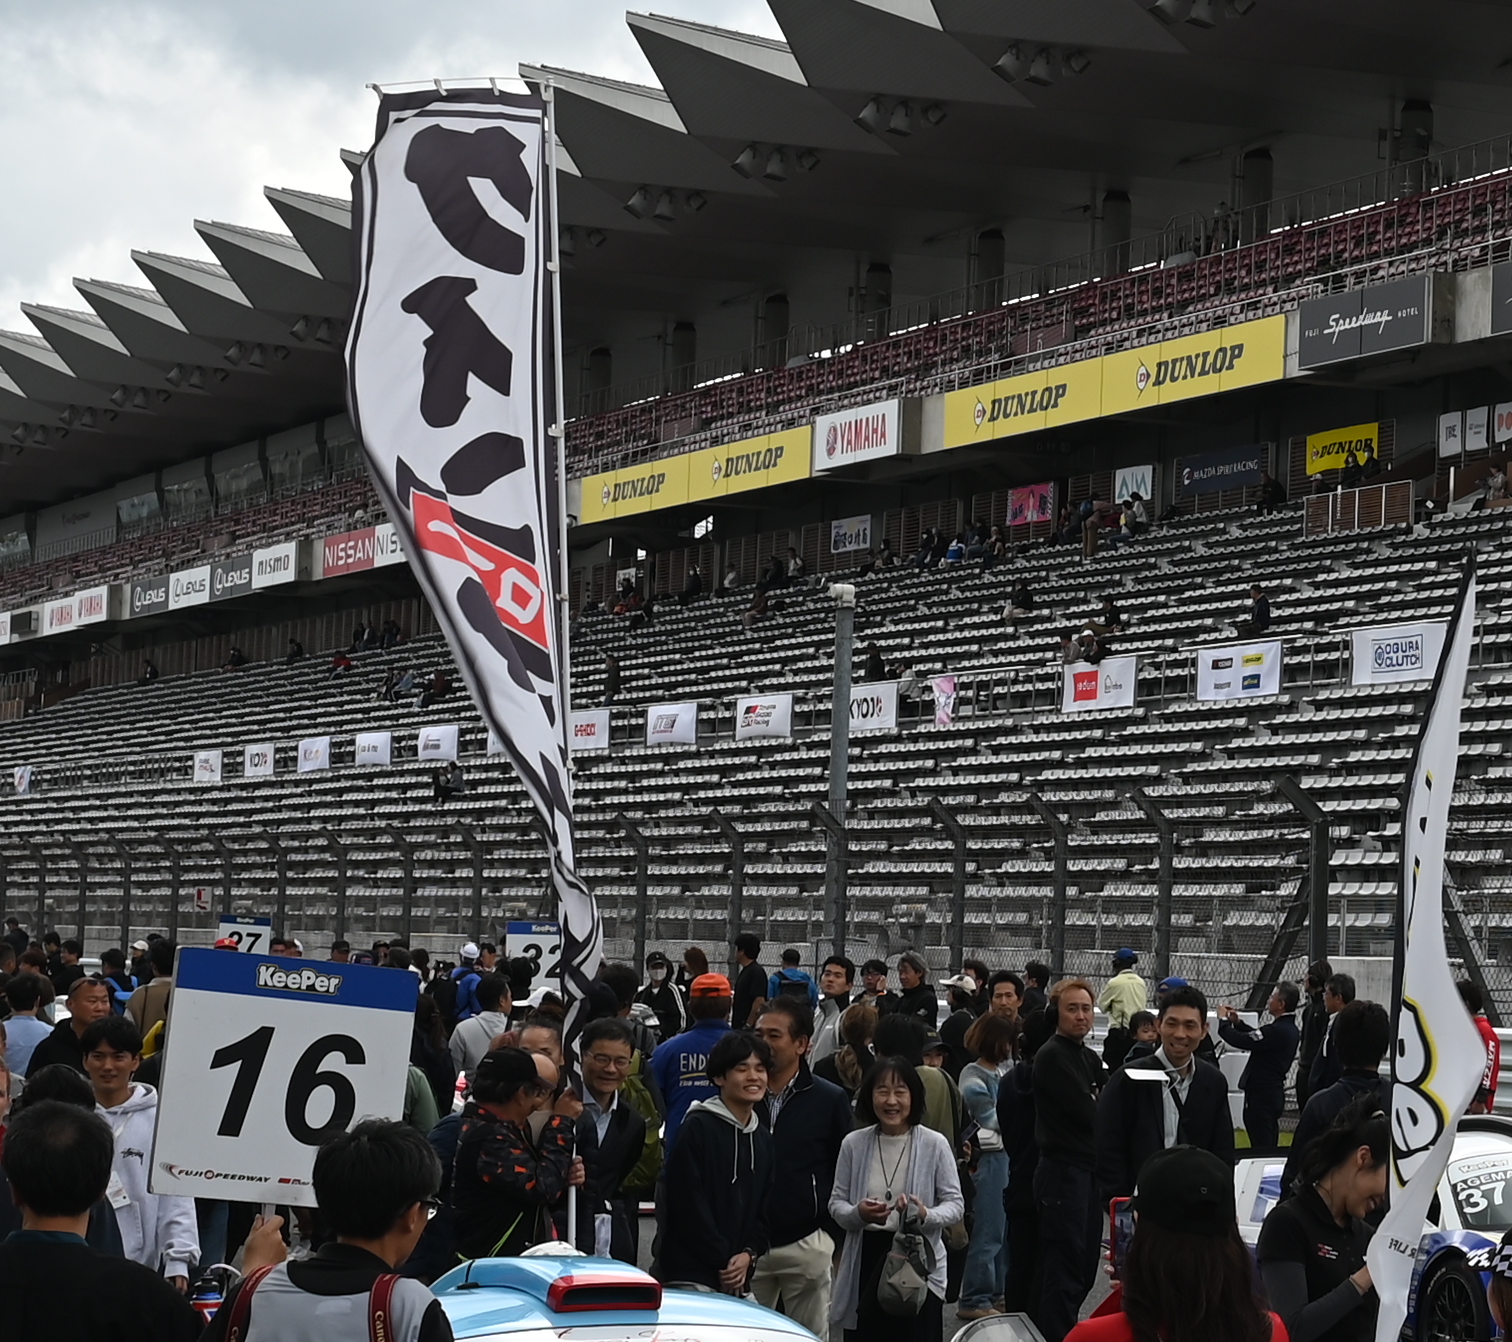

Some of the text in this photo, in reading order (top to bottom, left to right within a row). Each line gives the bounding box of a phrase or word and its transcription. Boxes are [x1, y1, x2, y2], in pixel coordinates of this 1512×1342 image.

[1323, 307, 1393, 344] Speedway
[1153, 343, 1244, 387] DUNLOP
[988, 383, 1067, 422] DUNLOP
[839, 413, 887, 455] YAMAHA
[723, 446, 785, 478] DUNLOP
[612, 473, 666, 502] DUNLOP
[324, 537, 374, 570] NISSAN
[1385, 640, 1419, 654] OGURA
[1385, 653, 1420, 667] CLUTCH
[257, 963, 341, 995] KeePer
[210, 1026, 366, 1147] 16
[178, 1169, 271, 1184] FUJI SPEEDWAY
[1458, 1181, 1506, 1214] 37
